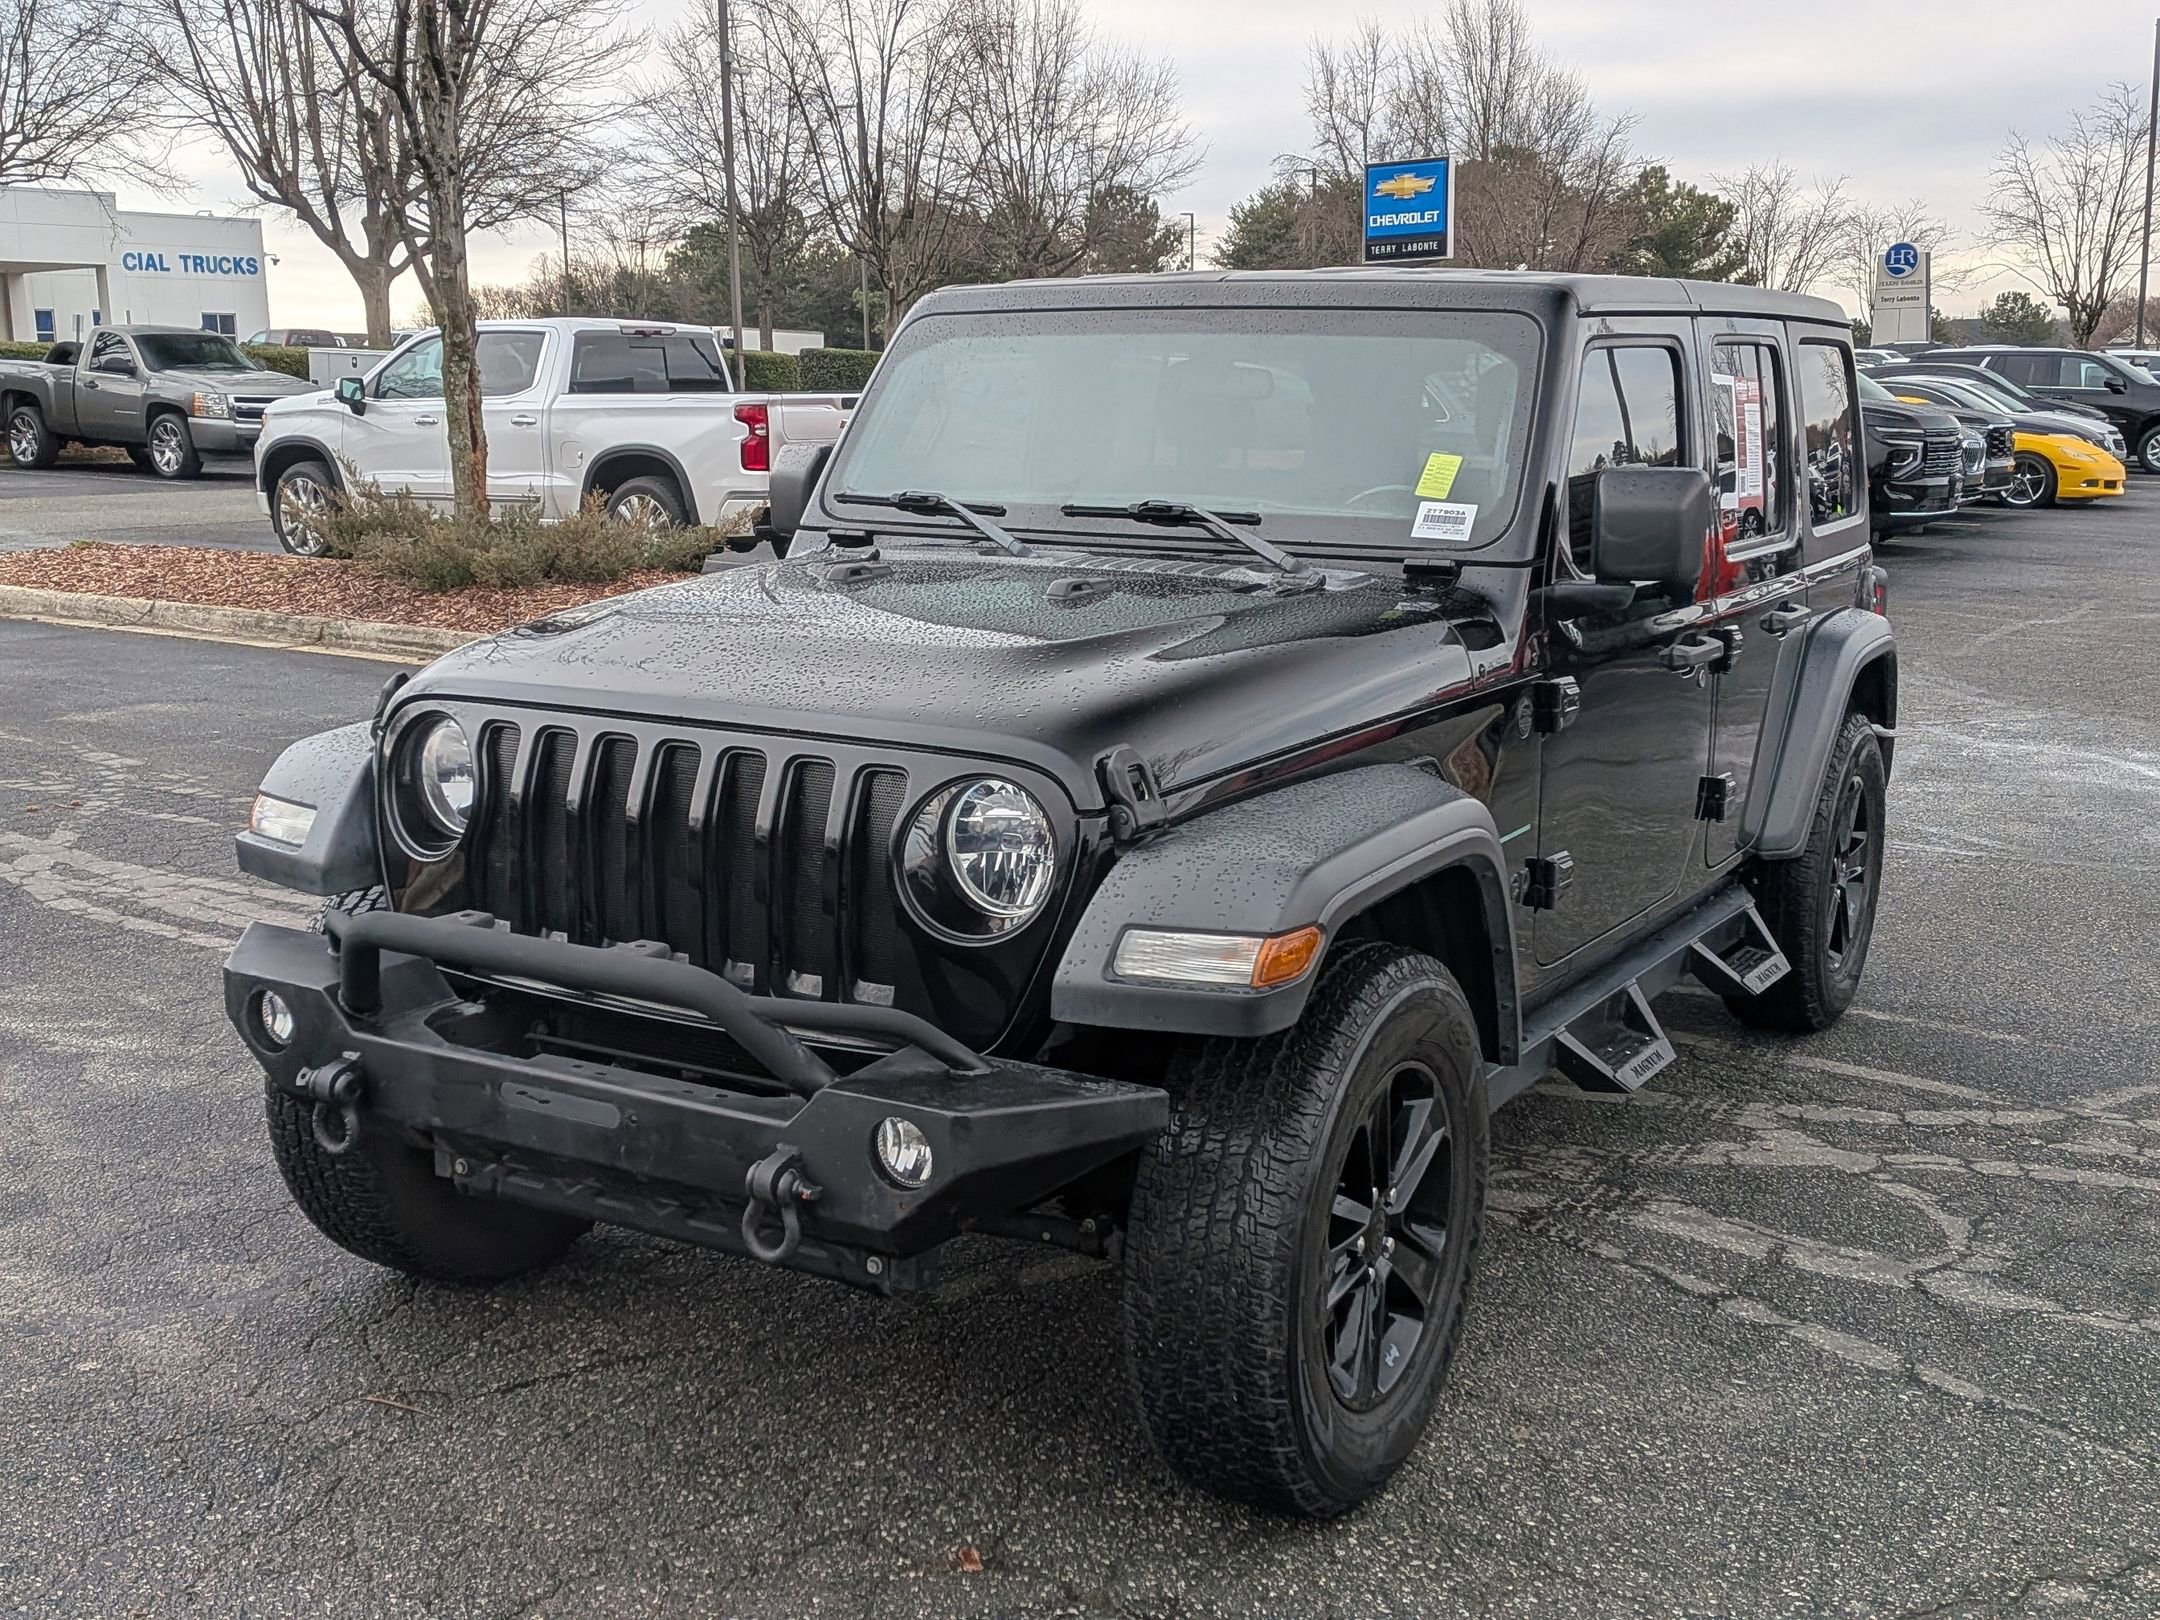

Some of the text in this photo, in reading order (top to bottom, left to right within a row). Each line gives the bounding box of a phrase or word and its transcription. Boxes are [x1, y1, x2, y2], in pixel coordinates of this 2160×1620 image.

[1369, 210, 1440, 227] CHEVROLET
[1371, 241, 1438, 255] TERRY LABONTE
[122, 252, 259, 275] CIAL TRUCKS
[1630, 1050, 1665, 1079] MAGNUM
